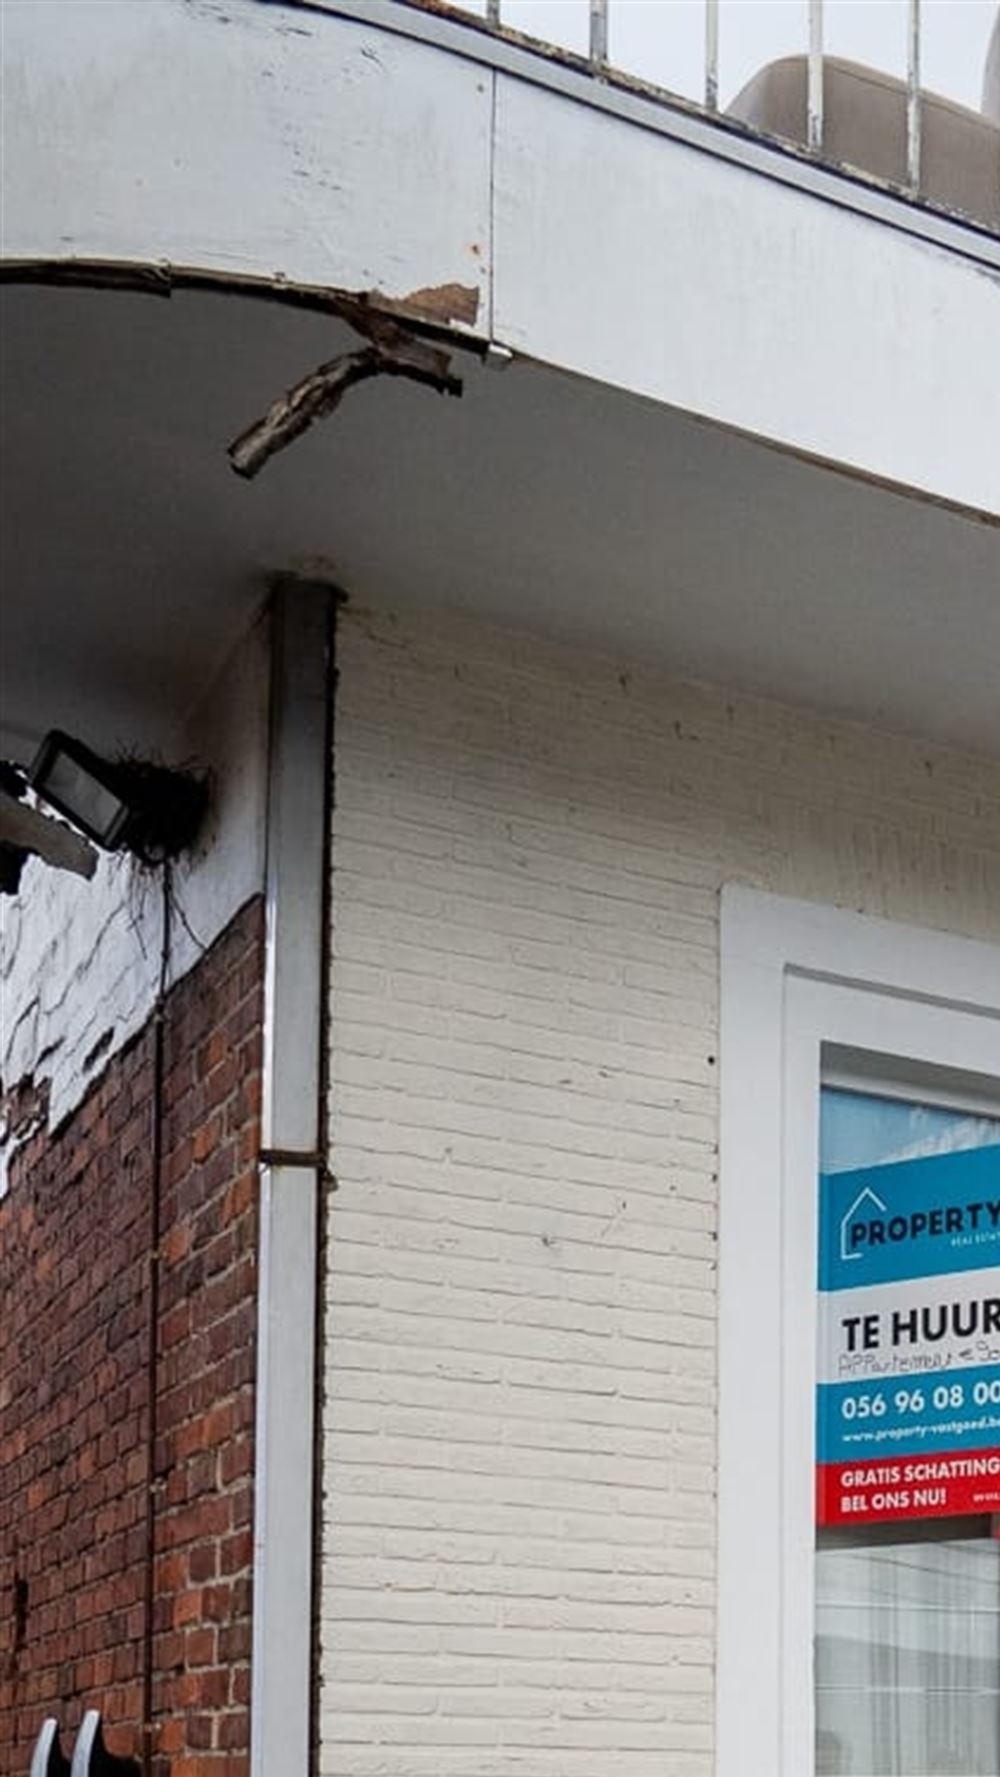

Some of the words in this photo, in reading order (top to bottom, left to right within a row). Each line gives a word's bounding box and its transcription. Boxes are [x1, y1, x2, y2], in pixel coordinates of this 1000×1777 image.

[842, 1314, 879, 1351] TE
[841, 1393, 887, 1420] 056
[894, 1389, 925, 1414] 96
[933, 1384, 964, 1410] 08
[841, 1466, 901, 1487] GRATIS
[841, 1496, 868, 1513] BEL
[871, 1492, 909, 1508] ONS
[914, 1488, 947, 1506] NU!
